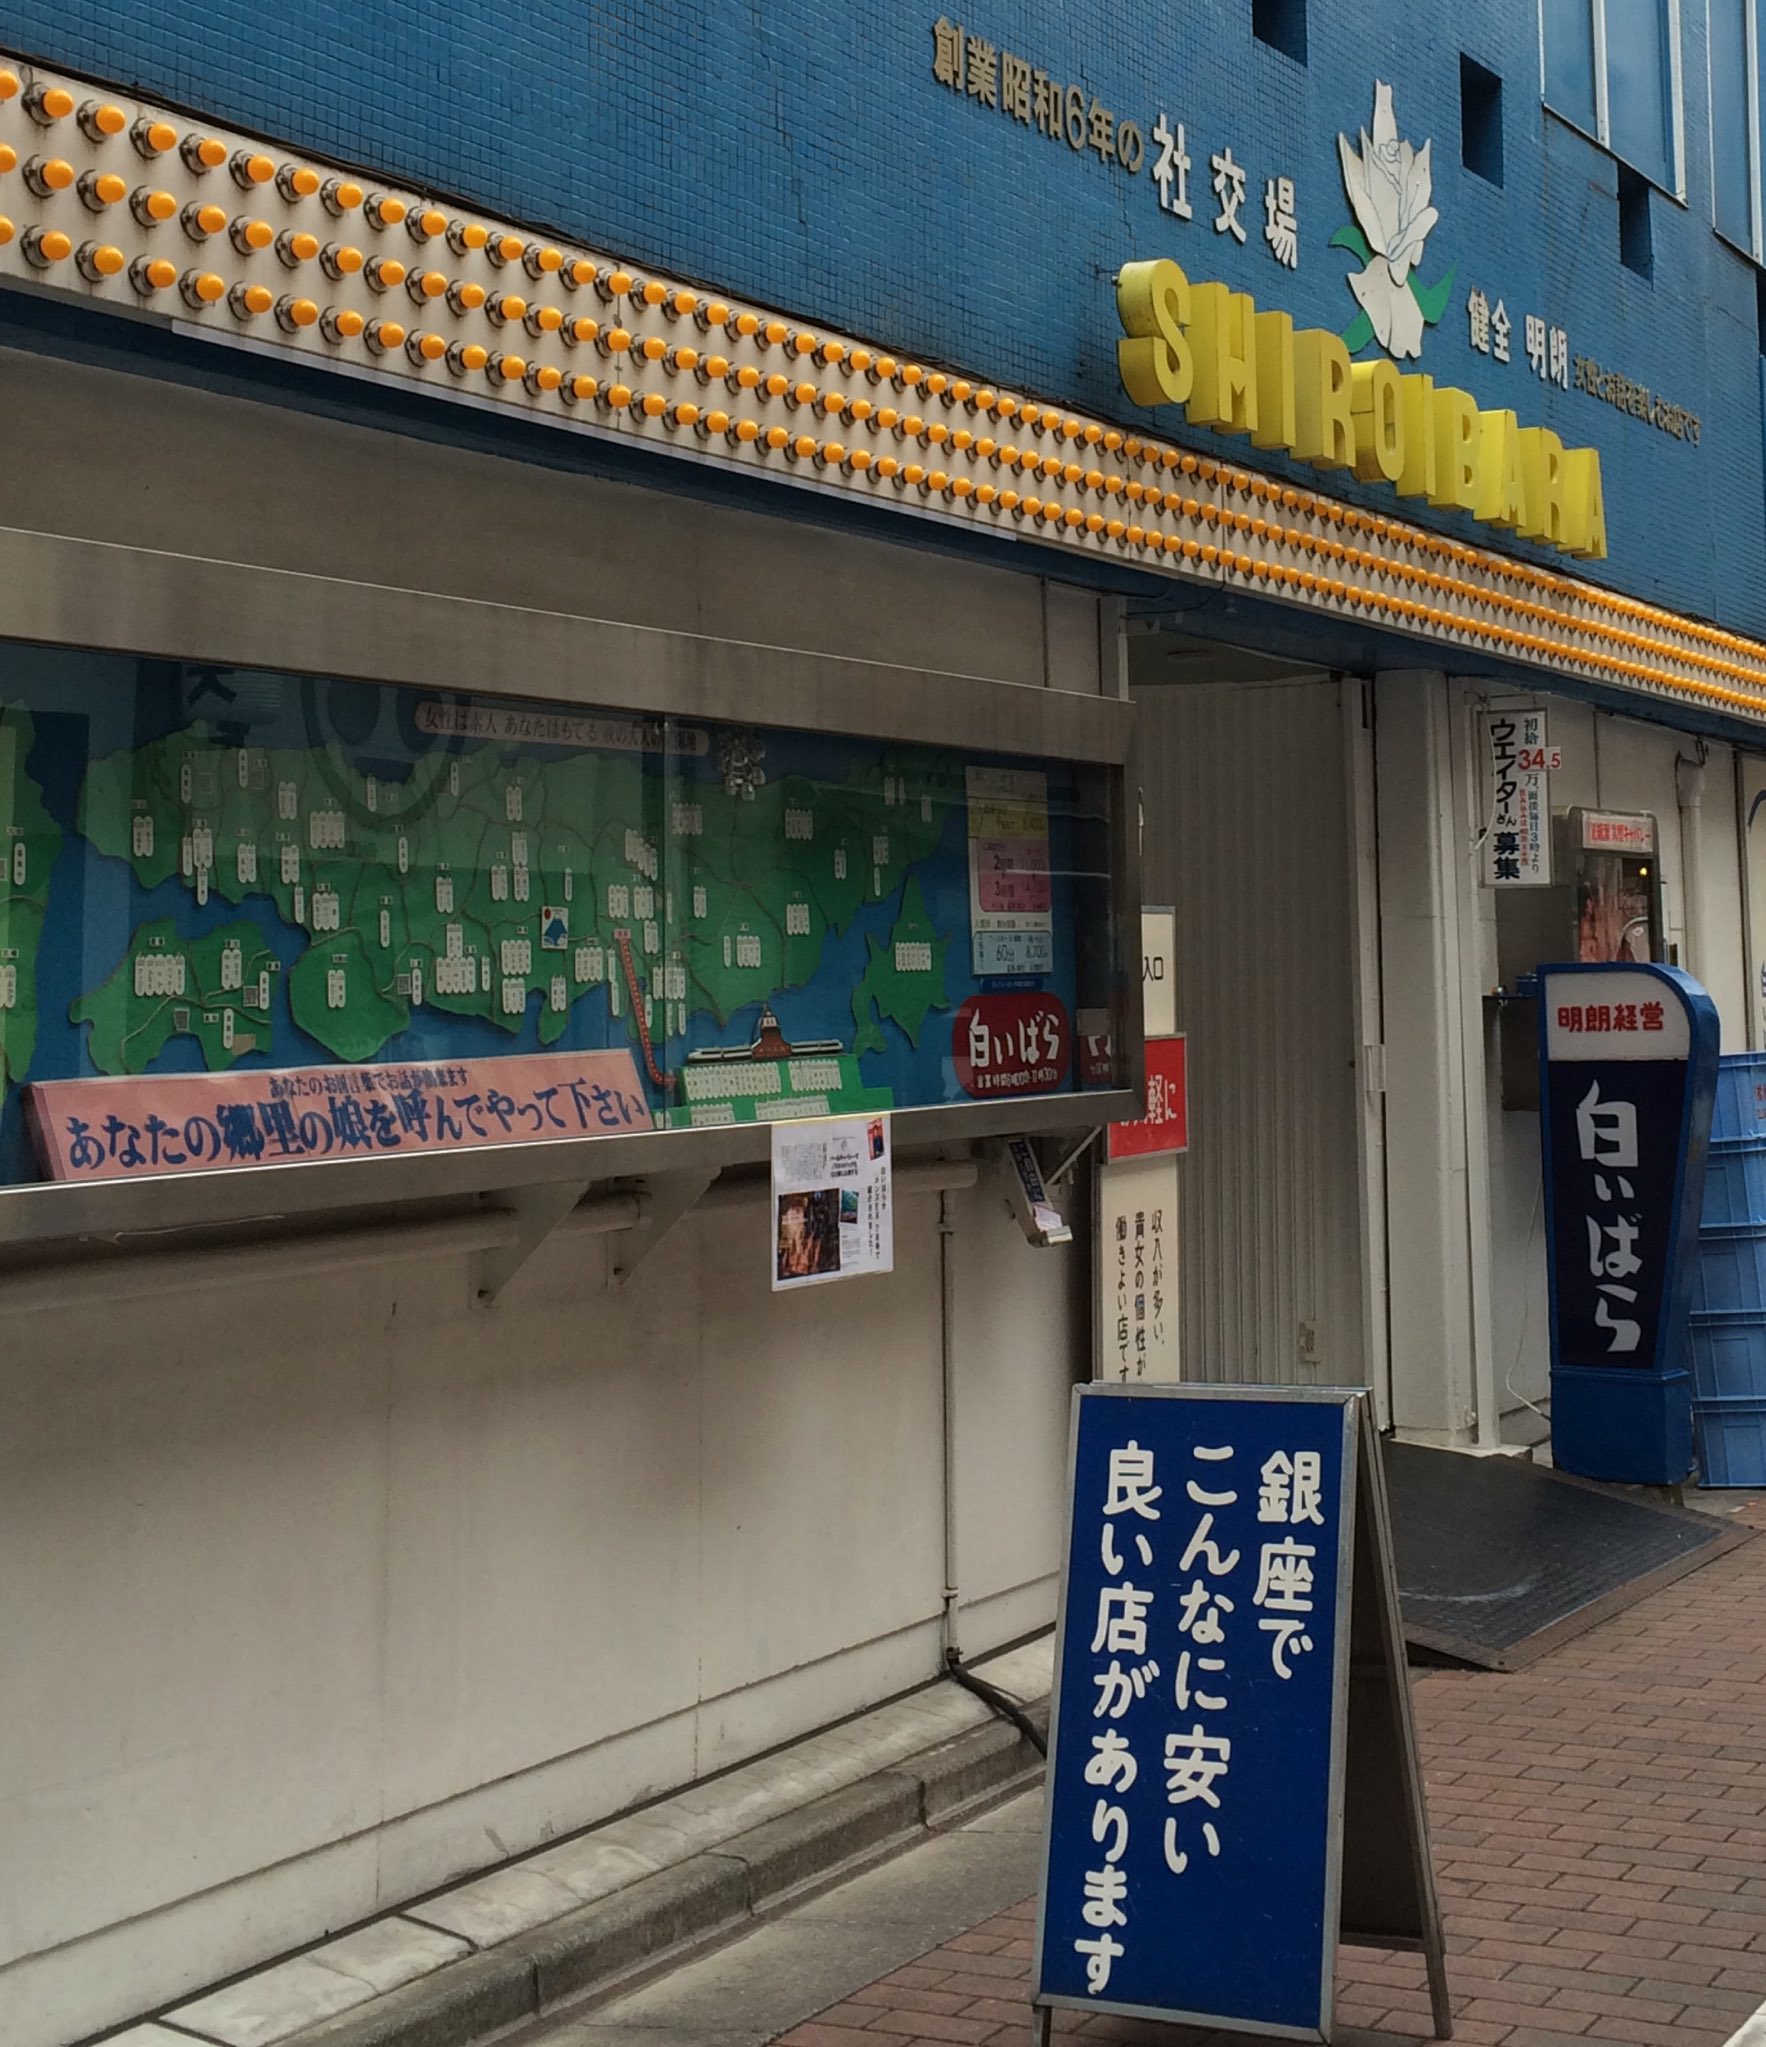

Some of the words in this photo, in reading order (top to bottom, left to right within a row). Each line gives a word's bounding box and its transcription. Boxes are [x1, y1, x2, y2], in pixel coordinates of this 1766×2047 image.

[932, 16, 1144, 172] 創業昭和6年の
[1152, 113, 1298, 270] 社交場
[1116, 258, 1608, 559] SHIROIBARA
[1467, 285, 1512, 364] 健全
[1525, 313, 1568, 390] 明朗
[968, 1007, 1061, 1069] 白いばら
[1557, 1001, 1665, 1032] 明朗経営
[1576, 1079, 1643, 1352] 白いばら
[1163, 1445, 1240, 1874] こんなに安い
[1252, 1450, 1325, 1680] 銀座で
[1074, 1440, 1163, 1995] 良い店があります
